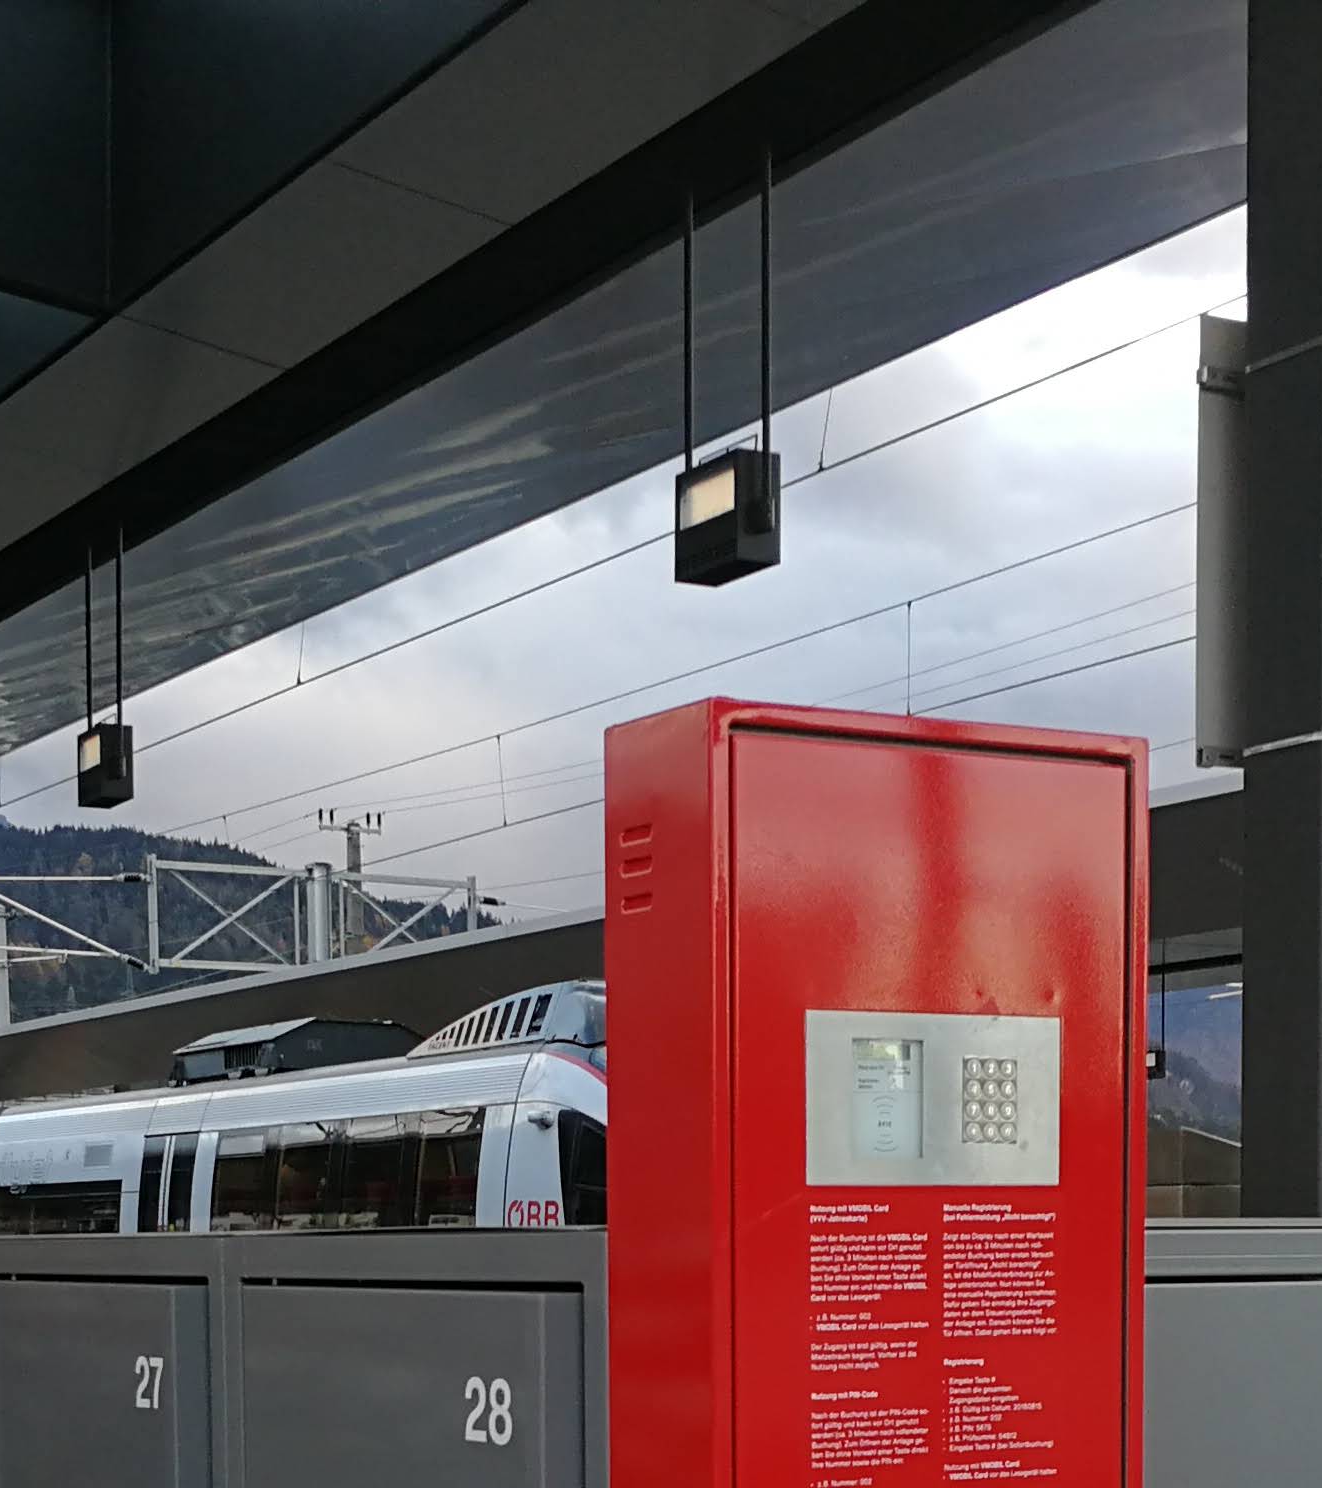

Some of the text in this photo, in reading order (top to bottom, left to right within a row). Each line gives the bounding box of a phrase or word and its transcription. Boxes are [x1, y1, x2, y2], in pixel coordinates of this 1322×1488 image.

[507, 1200, 559, 1227] ÖBB
[134, 1355, 164, 1410] 27
[465, 1376, 513, 1446] 28
